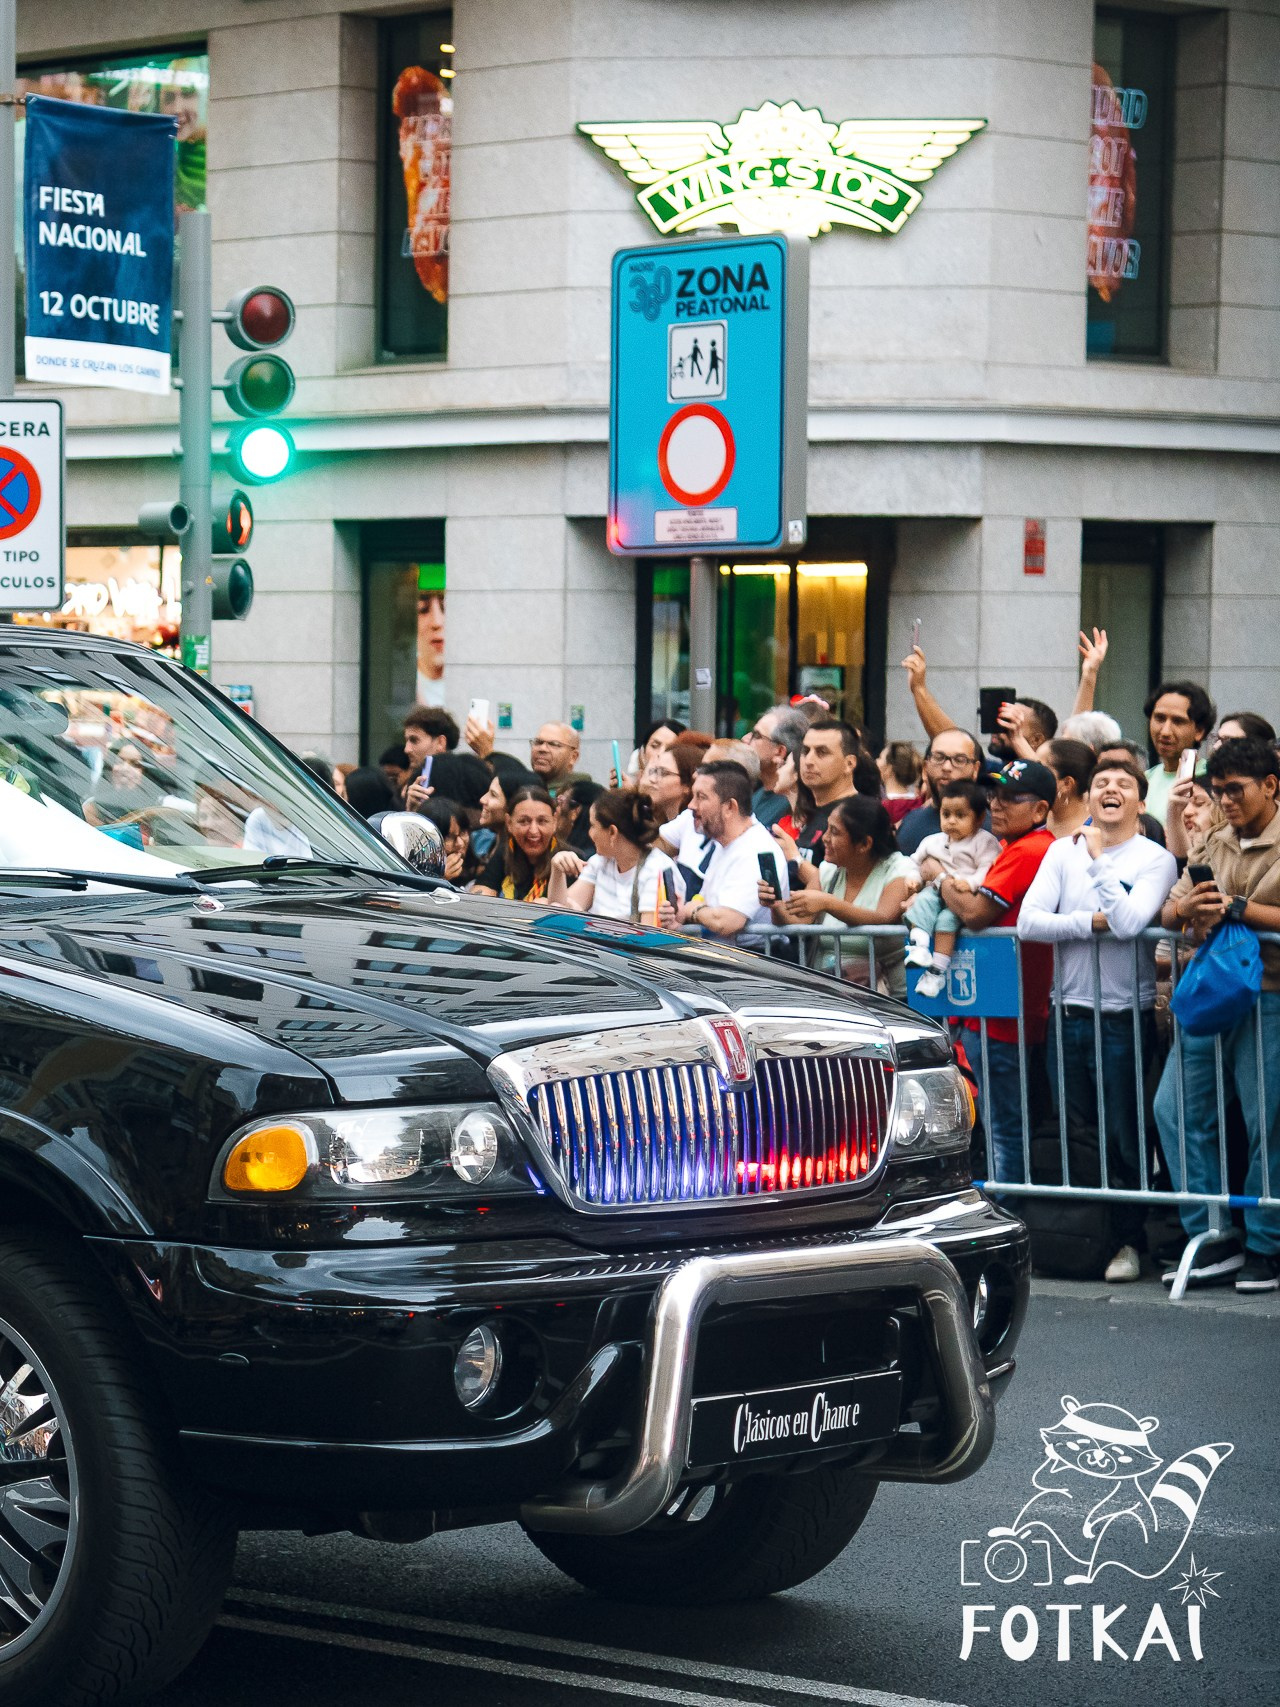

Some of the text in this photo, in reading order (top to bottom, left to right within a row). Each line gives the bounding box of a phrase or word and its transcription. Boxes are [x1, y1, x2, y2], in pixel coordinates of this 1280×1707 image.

[39, 185, 106, 218] FIESTA
[38, 220, 147, 258] NACIONAL
[676, 261, 770, 299] ZONA
[39, 290, 161, 336] 12 OCTUBRE
[675, 293, 771, 318] PEATONAL
[36, 355, 67, 367] DONDE
[70, 358, 80, 368] SE
[82, 359, 117, 373] CRUZAN
[119, 363, 133, 374] LOS
[3, 550, 40, 563] TIPO
[733, 1402, 791, 1453] Clásicos
[793, 1410, 809, 1436] en
